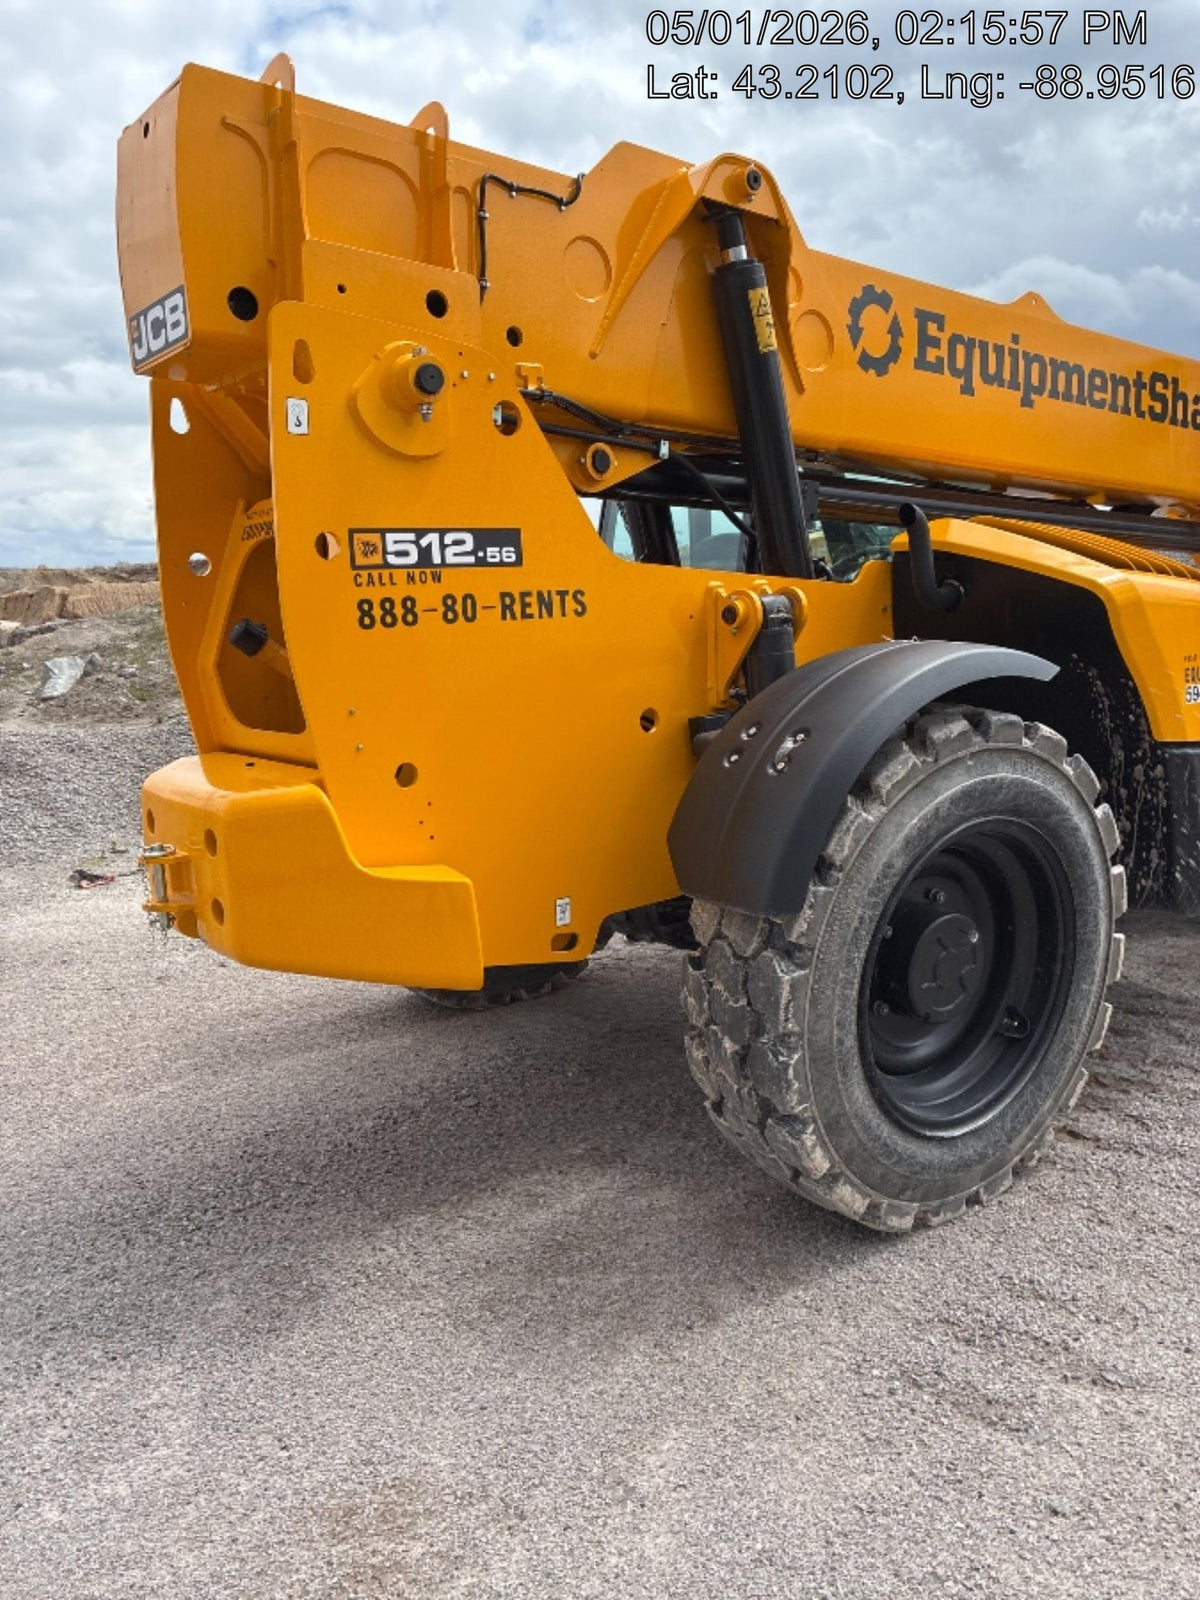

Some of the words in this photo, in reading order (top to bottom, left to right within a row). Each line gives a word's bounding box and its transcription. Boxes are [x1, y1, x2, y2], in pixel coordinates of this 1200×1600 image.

[133, 292, 186, 360] JCB
[353, 572, 397, 588] CALL
[406, 570, 443, 585] NOW
[357, 588, 587, 630] 888-80-RENTS
